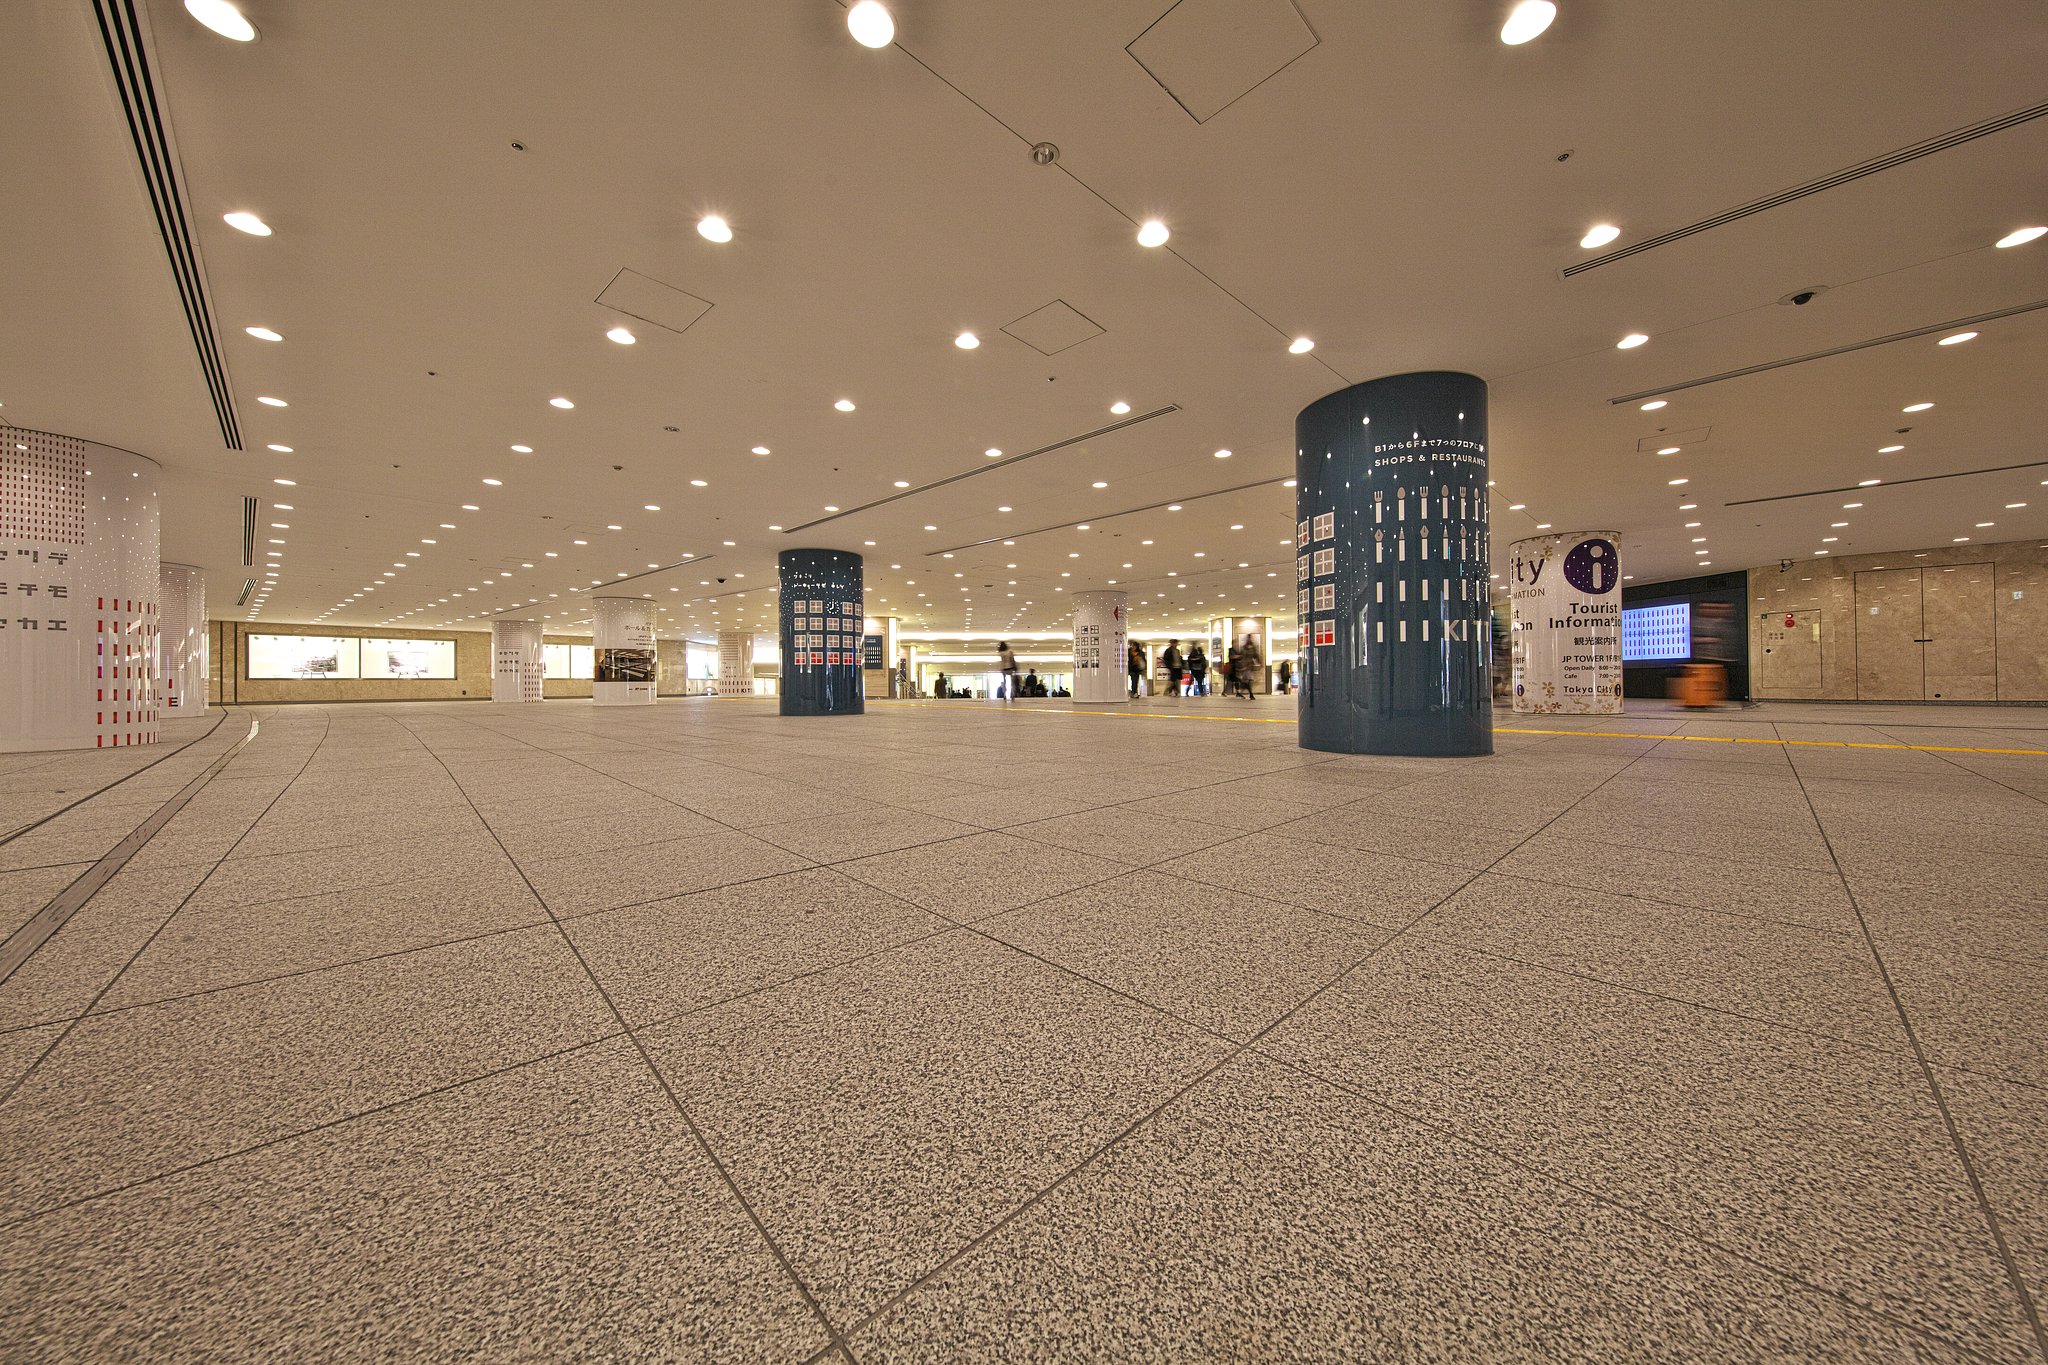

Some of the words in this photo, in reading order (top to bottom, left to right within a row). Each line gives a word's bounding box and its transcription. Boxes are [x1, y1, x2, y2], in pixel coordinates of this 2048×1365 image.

[1375, 455, 1413, 467] SHOPS
[1432, 454, 1486, 468] RESTAURANTS
[1570, 602, 1618, 615] Tourist
[1574, 636, 1617, 647] 観光案内所
[1562, 655, 1572, 663] JP
[1574, 655, 1604, 663] TOWER
[1563, 685, 1593, 694] Tokyo
